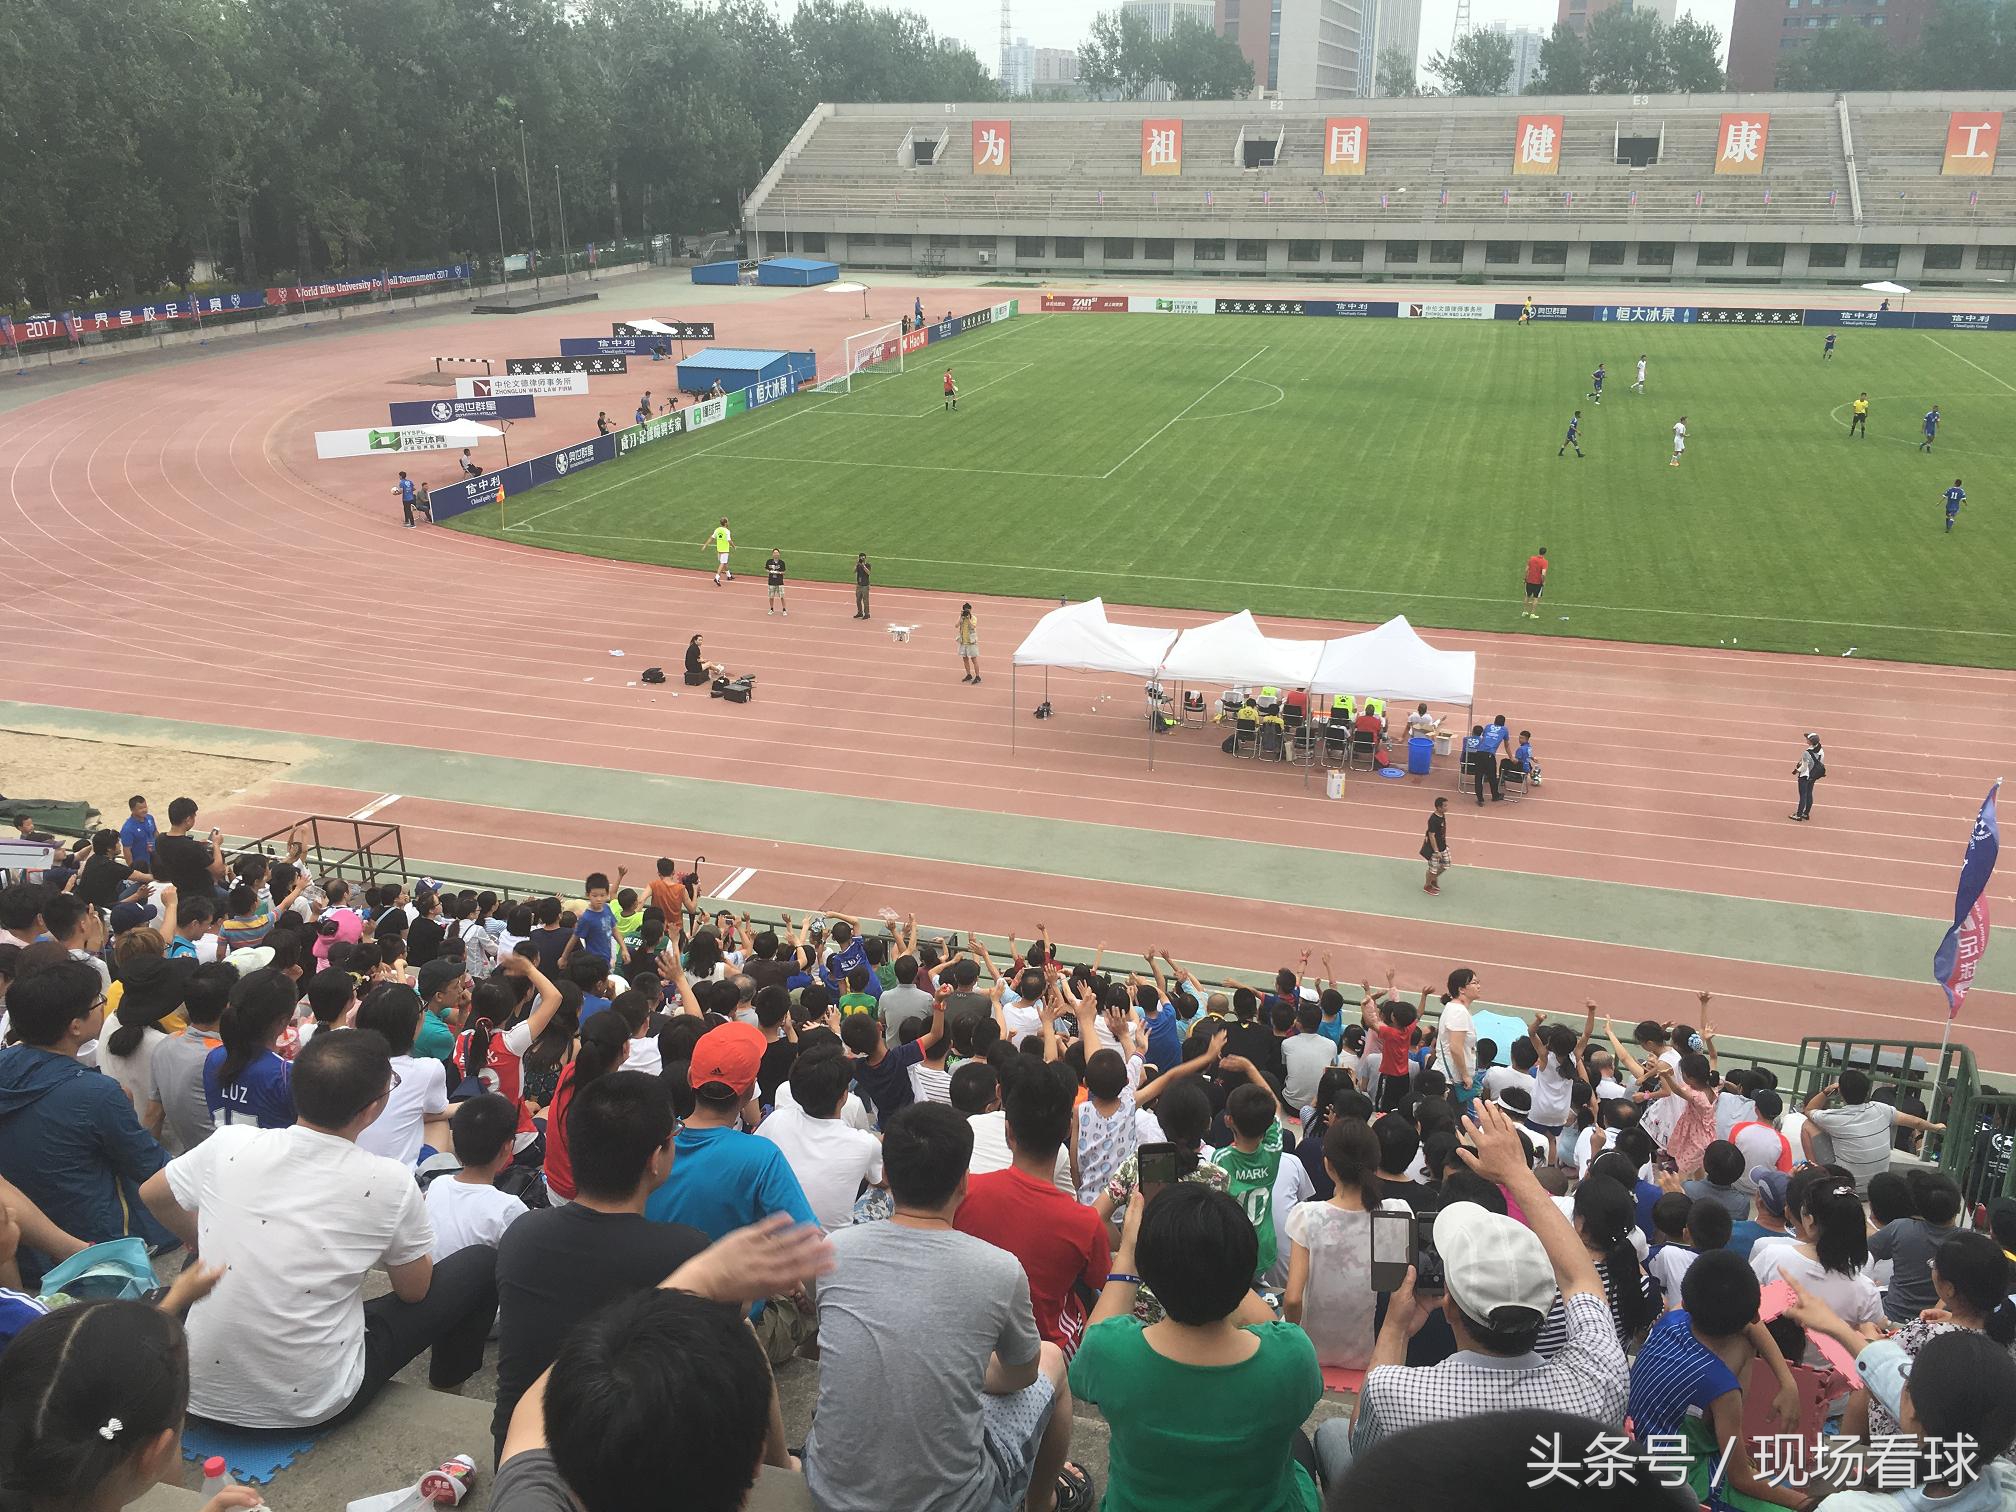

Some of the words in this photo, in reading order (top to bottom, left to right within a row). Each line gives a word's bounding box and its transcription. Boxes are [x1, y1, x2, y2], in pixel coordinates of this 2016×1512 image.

[1270, 101, 1284, 111] E2
[1633, 96, 1649, 105] E3
[945, 104, 957, 113] E1
[979, 128, 1005, 166] 为
[1147, 128, 1177, 167] 祖
[1329, 126, 1363, 165] 国
[1519, 123, 1557, 164] 健
[1720, 122, 1762, 163] 康
[1951, 124, 1992, 159] 工
[296, 285, 319, 298] World
[320, 284, 336, 295] Elite
[336, 280, 371, 293] University
[398, 272, 436, 284] Tournament
[26, 319, 57, 338] 2017
[73, 297, 222, 331] 世界名校足赛
[1616, 307, 1675, 322] 恒大冰泉
[1952, 314, 1990, 322] 信中利
[597, 339, 635, 347] 信中利
[494, 377, 571, 388] 中伦文德律师事务所
[756, 376, 788, 403] 恒大冰泉
[465, 475, 500, 496] 信中利
[1950, 492, 1958, 500] 11
[1235, 1166, 1269, 1180] MARK
